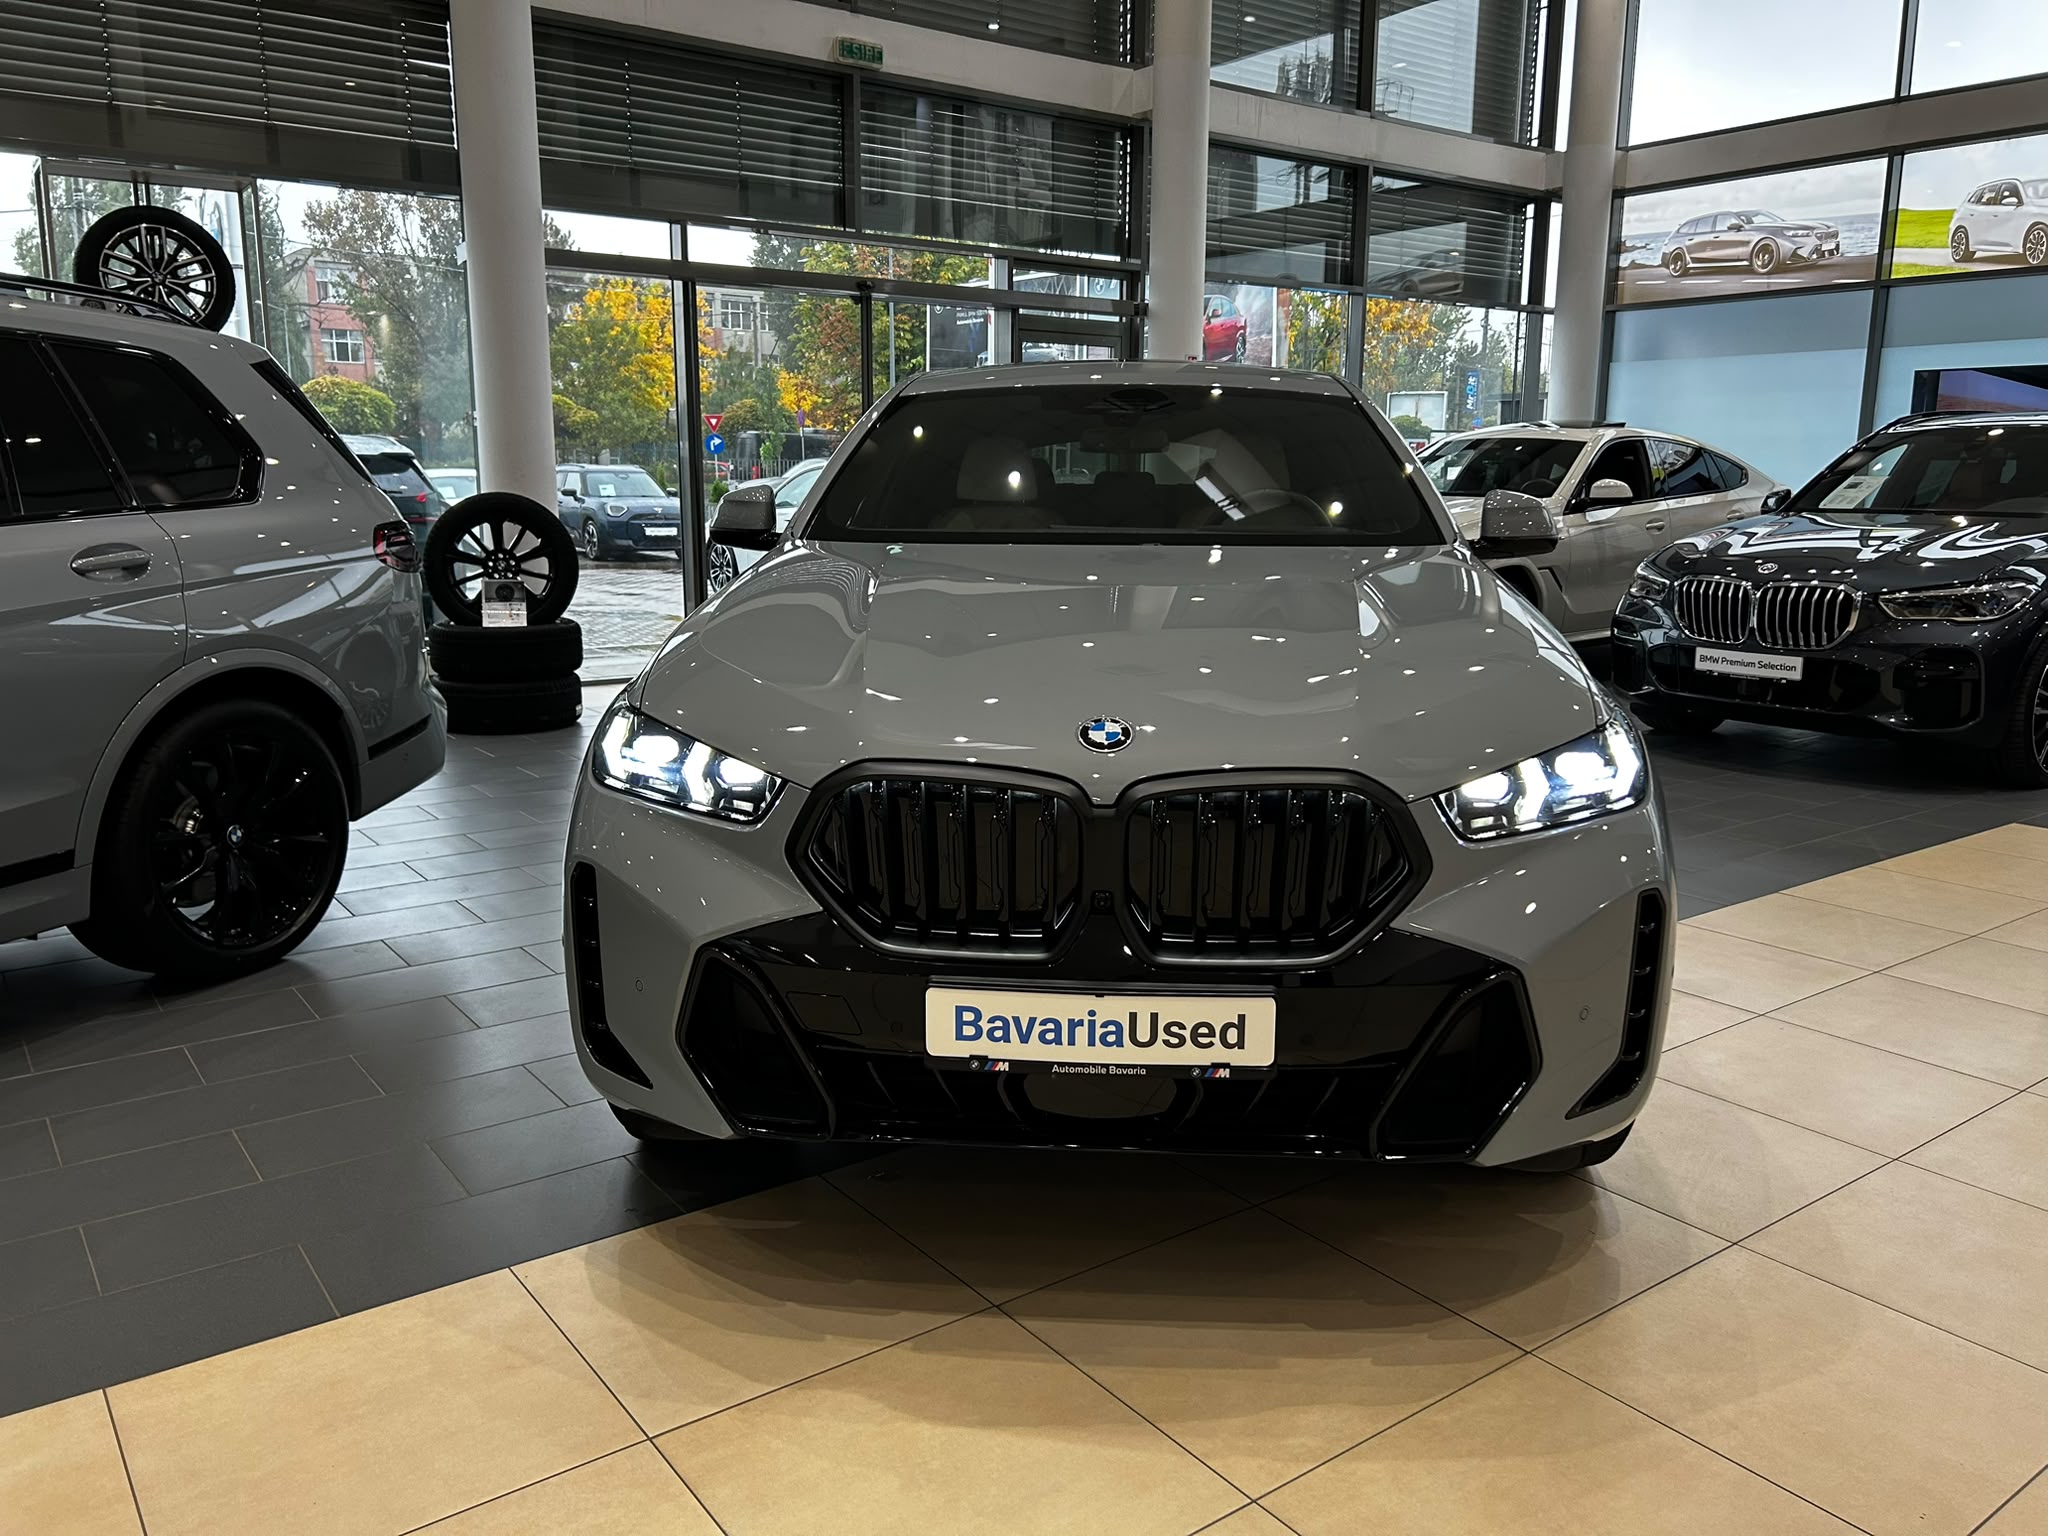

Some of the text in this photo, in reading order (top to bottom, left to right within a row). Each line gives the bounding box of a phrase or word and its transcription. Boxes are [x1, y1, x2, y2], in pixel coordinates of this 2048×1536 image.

[1699, 654, 1797, 672] BMW Premium Selection
[954, 1004, 1247, 1050] BavariaUsed
[1051, 1064, 1147, 1075] Automobile Bavaria
